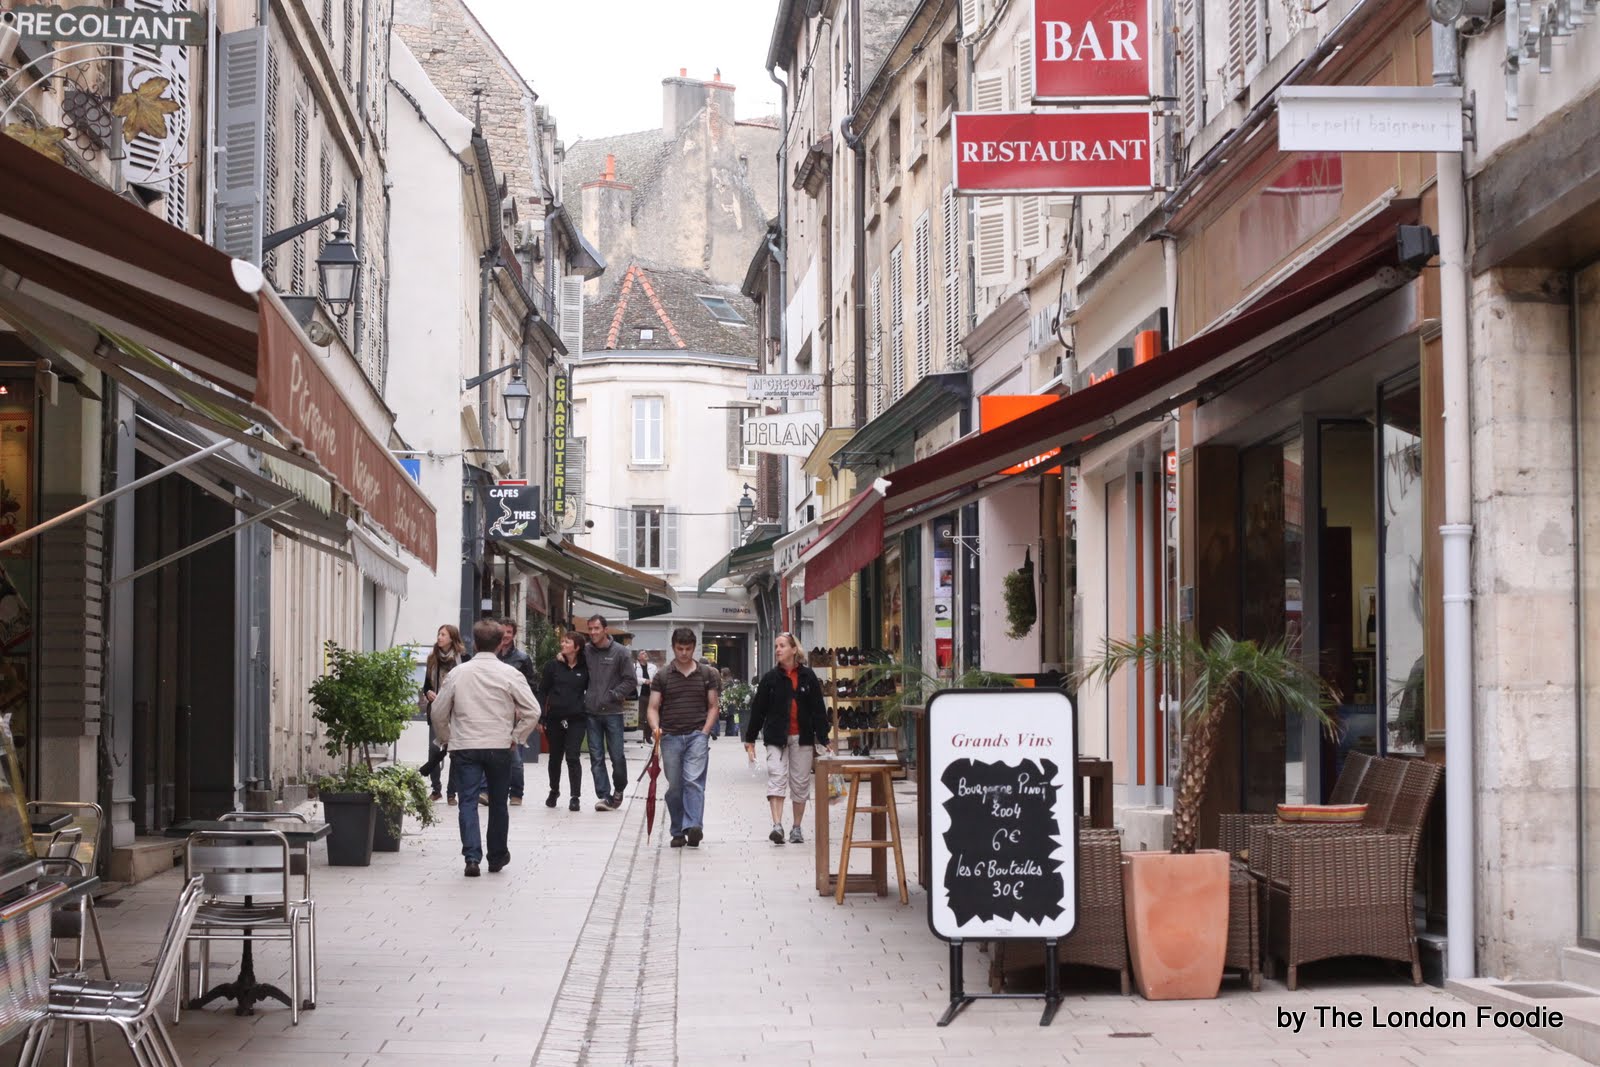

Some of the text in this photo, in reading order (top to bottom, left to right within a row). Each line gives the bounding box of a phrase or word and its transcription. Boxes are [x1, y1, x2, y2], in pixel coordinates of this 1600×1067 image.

[16, 12, 192, 41] RECOLTANT
[1041, 20, 1142, 61] BAR
[961, 139, 1147, 163] RESTAURANT
[554, 378, 567, 512] CHARCUTERIE
[489, 488, 519, 499] CAFES
[513, 510, 537, 521] THES
[951, 732, 1054, 748] Grands Vins
[990, 801, 1022, 819] 2004
[956, 853, 971, 877] les
[987, 858, 1043, 878] Bouteilles
[992, 880, 1025, 901] 30€
